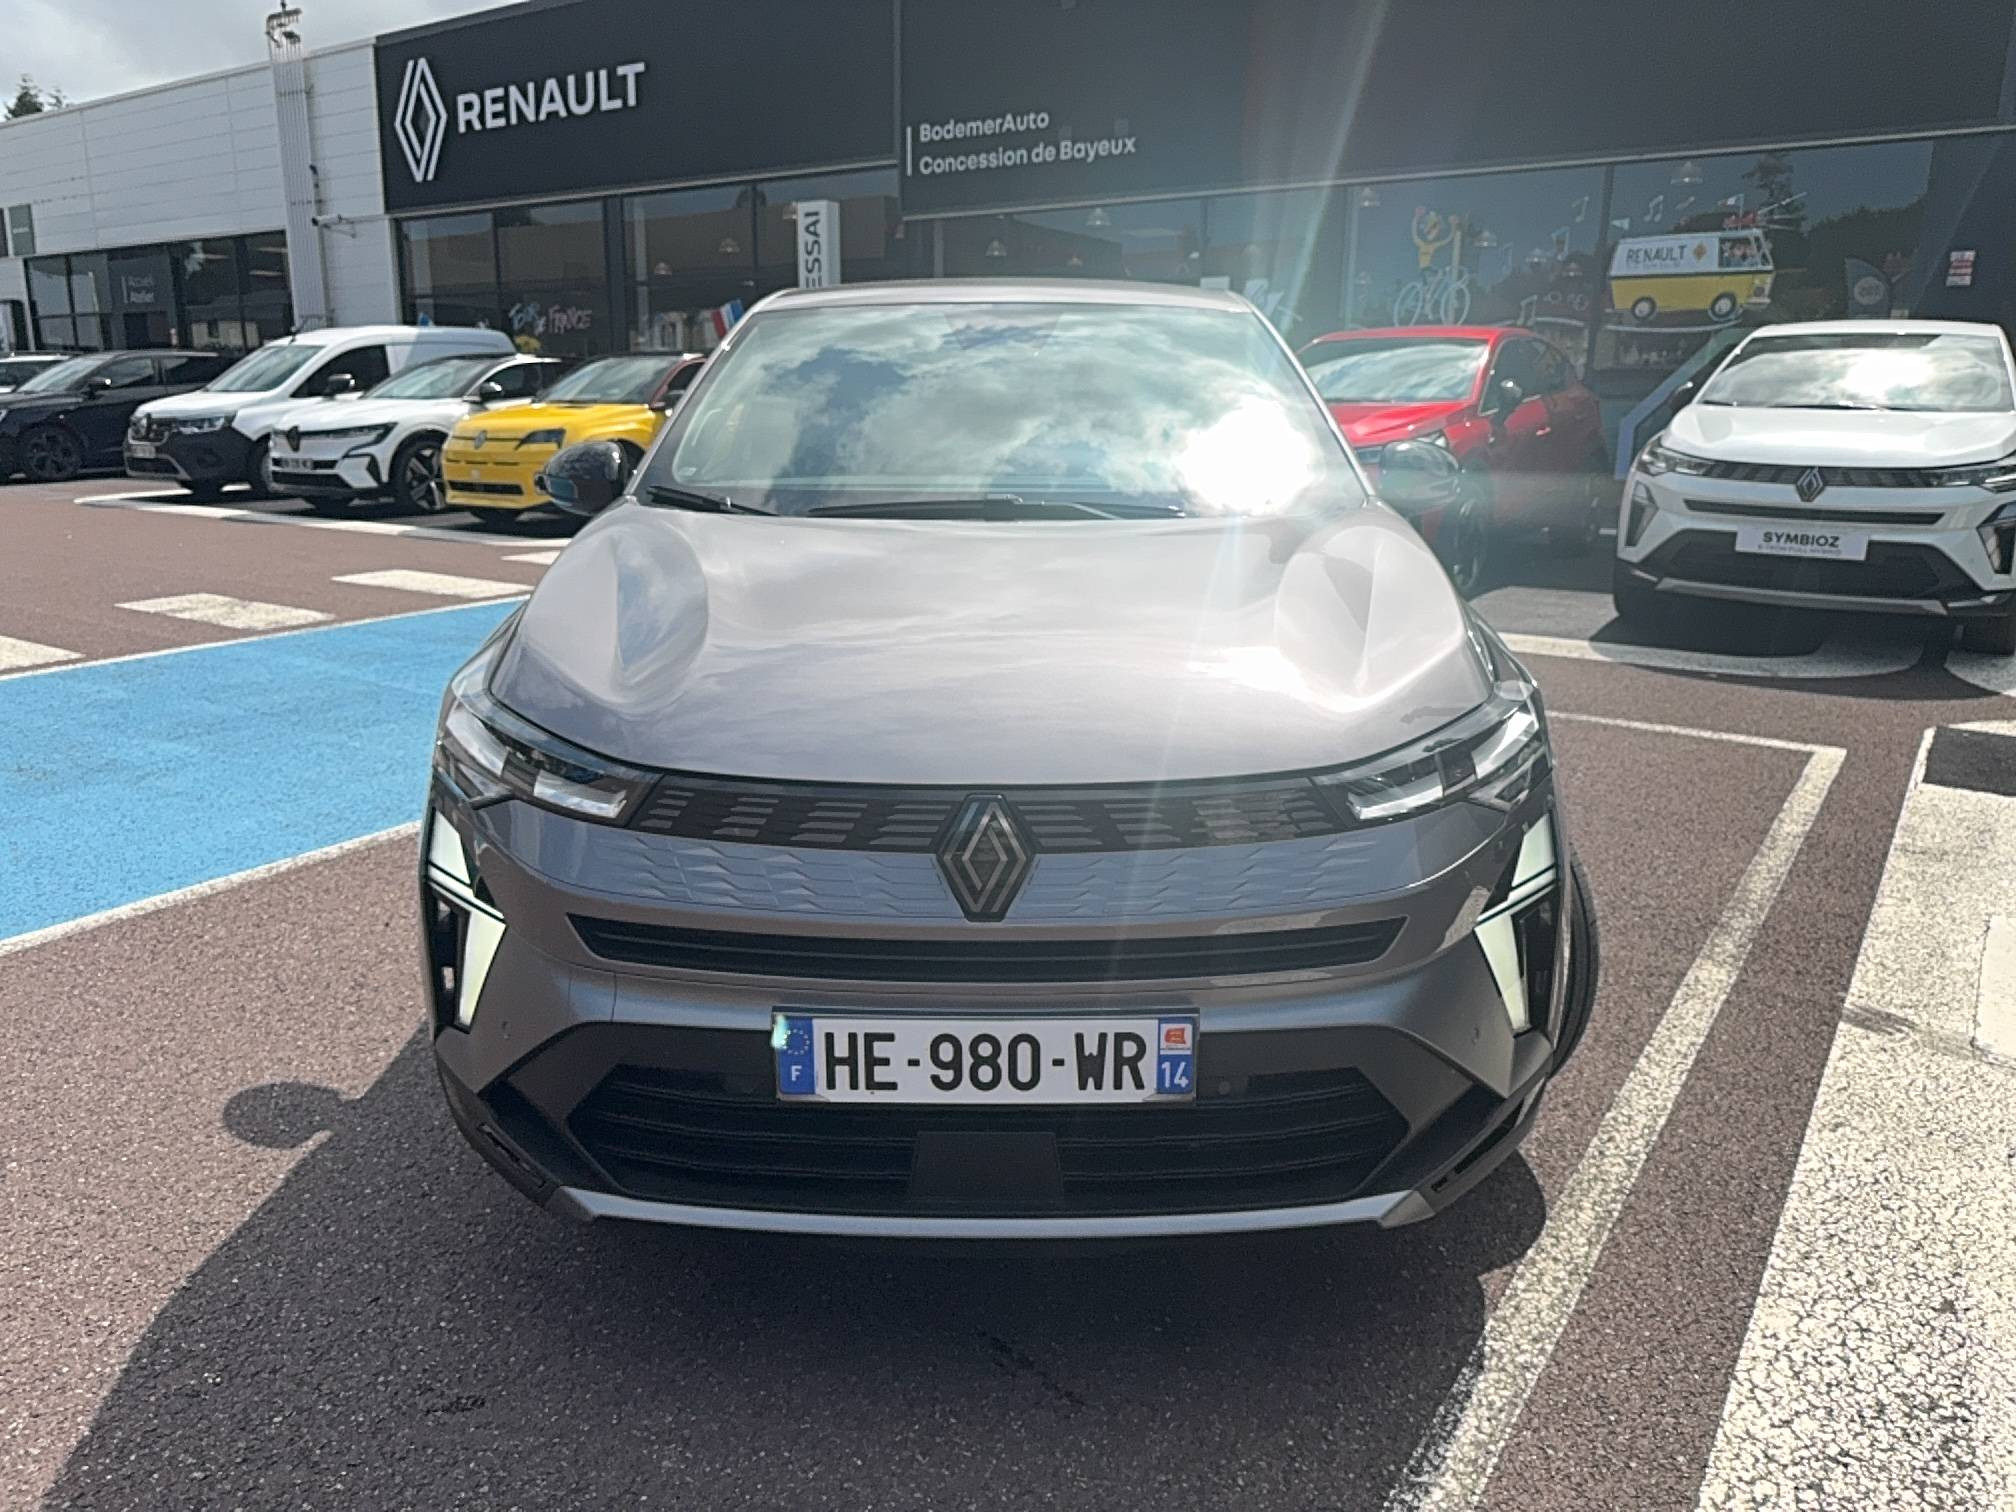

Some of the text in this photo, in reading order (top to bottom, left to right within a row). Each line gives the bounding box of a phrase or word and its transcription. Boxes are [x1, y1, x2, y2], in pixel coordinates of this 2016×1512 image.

[457, 62, 645, 134] RENAULT
[919, 111, 1049, 143] BodemerAuto
[918, 135, 1136, 175] Concession de Bayeux
[804, 211, 823, 288] ESSAI
[1625, 244, 1688, 264] RENAULT
[1763, 531, 1840, 548] SYMBIOZ
[790, 1065, 802, 1082] F
[825, 1031, 1147, 1092] HE-980-WR
[1161, 1061, 1189, 1089] 14
